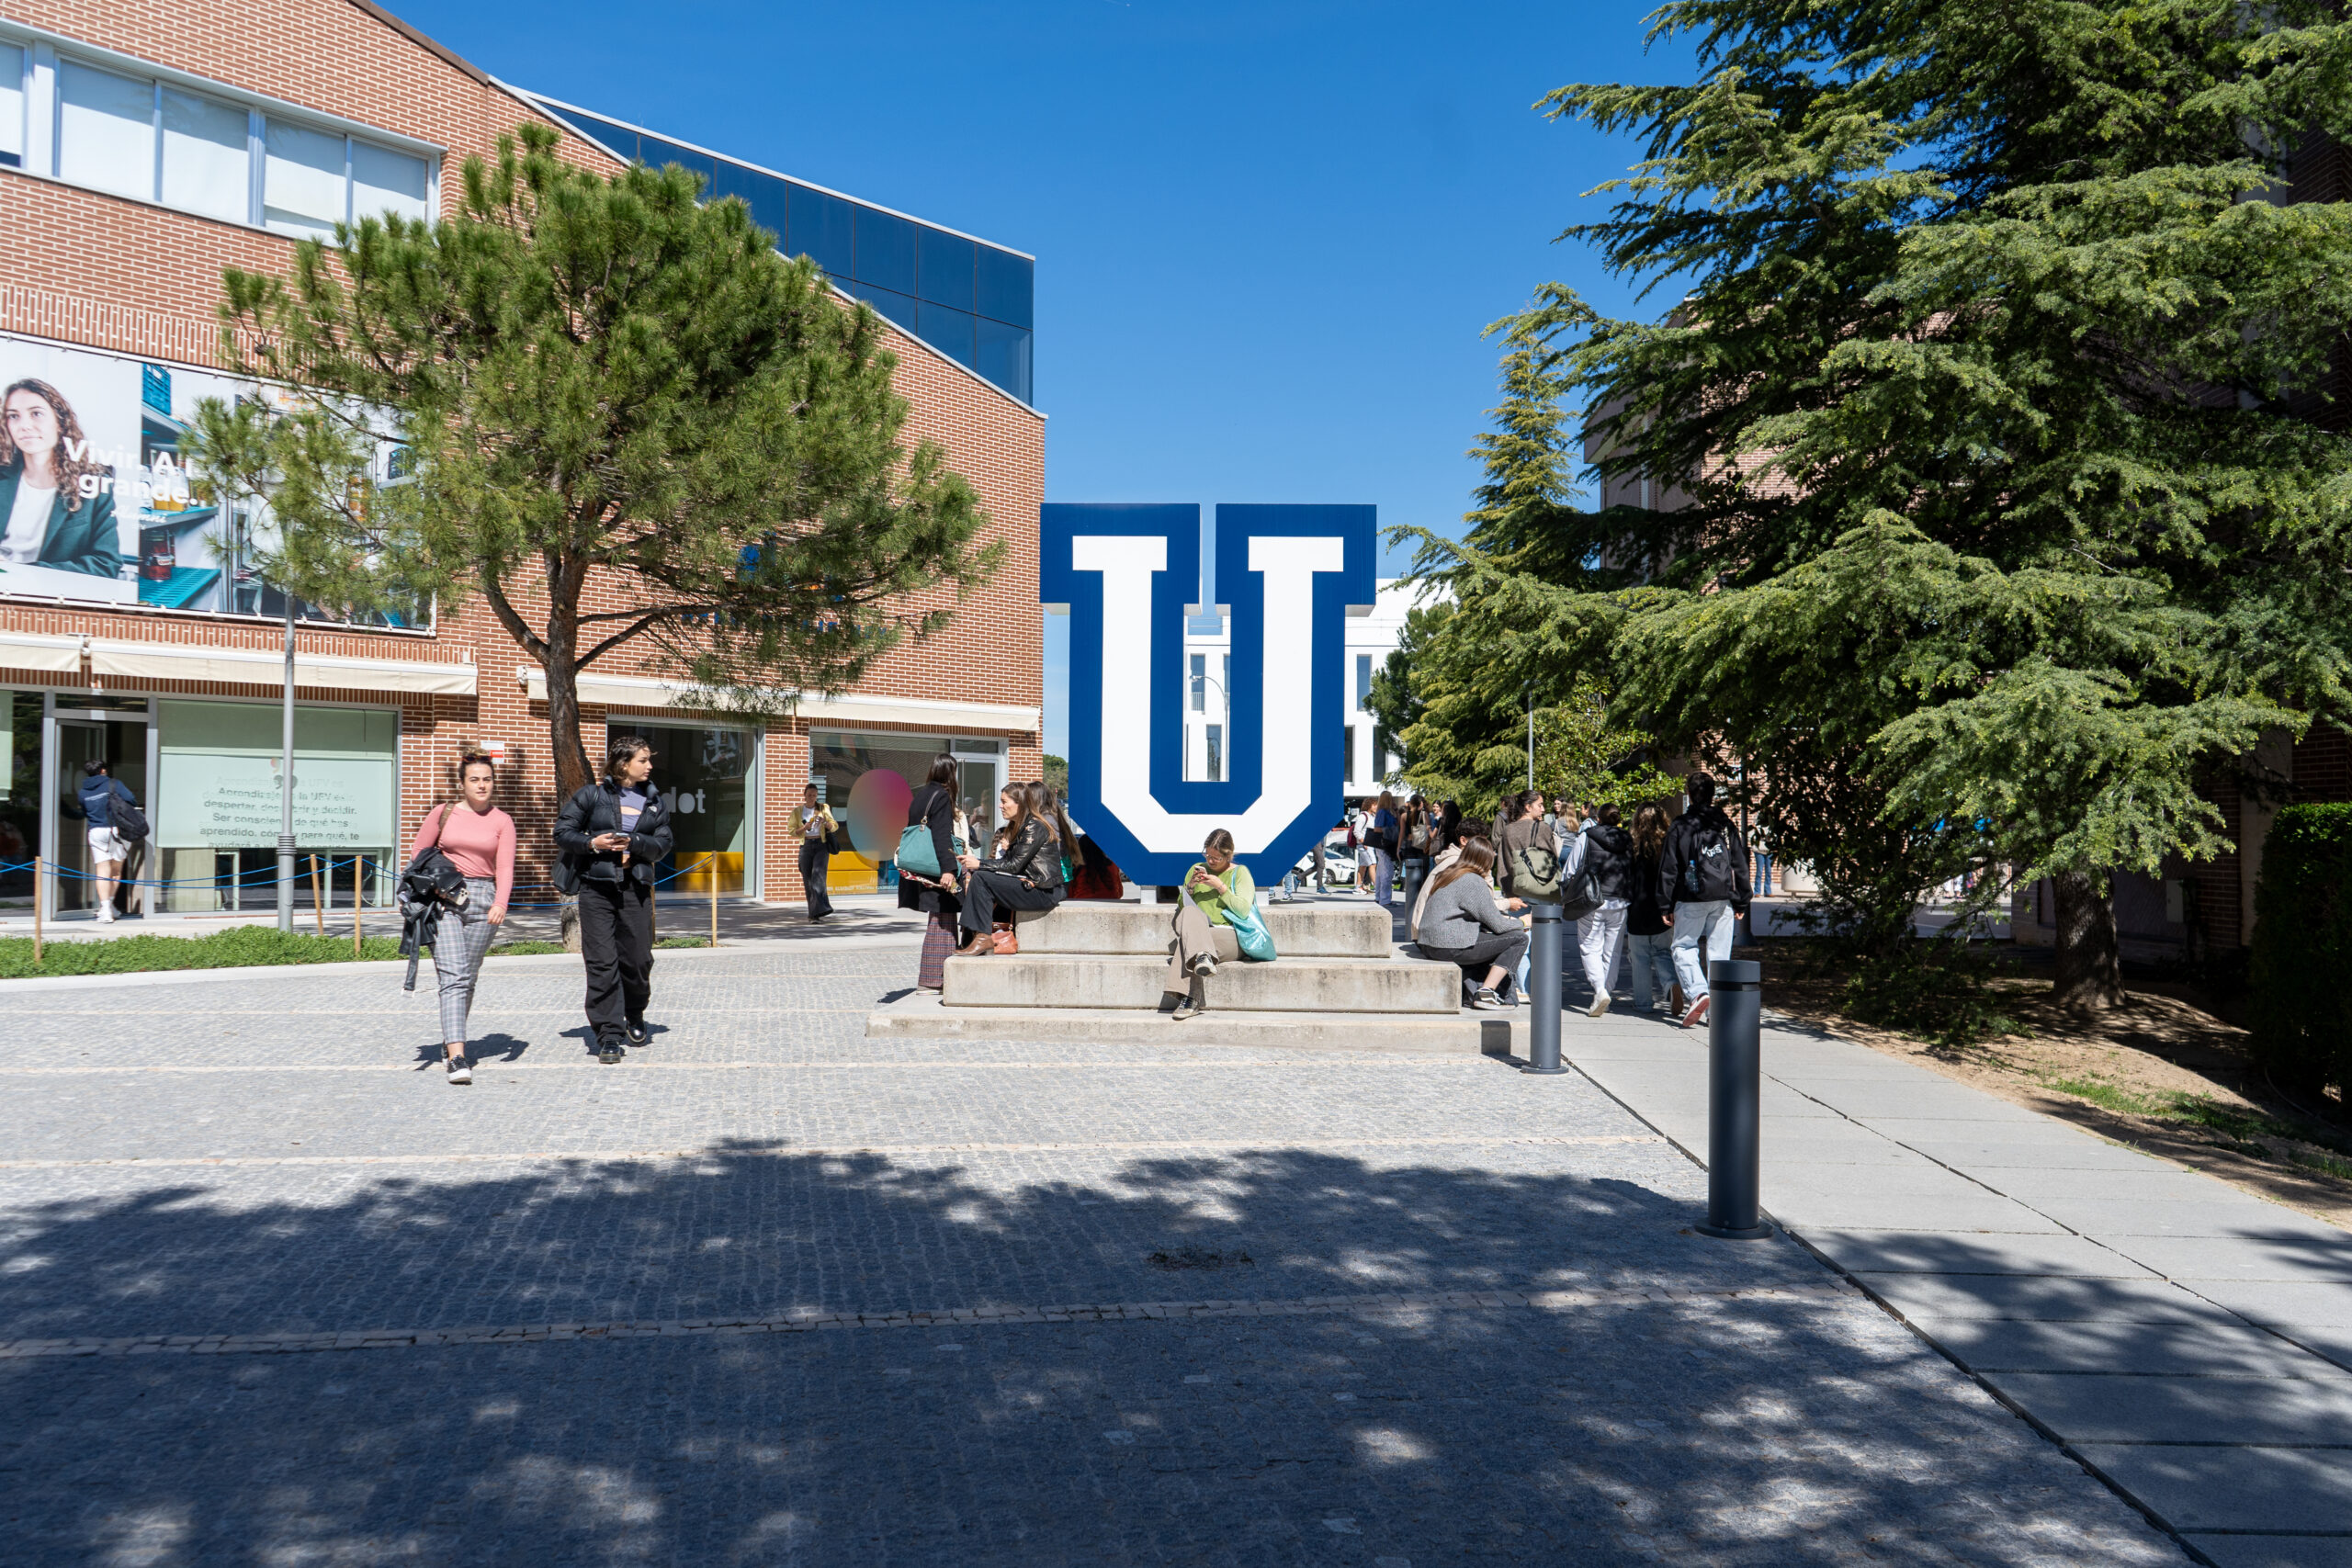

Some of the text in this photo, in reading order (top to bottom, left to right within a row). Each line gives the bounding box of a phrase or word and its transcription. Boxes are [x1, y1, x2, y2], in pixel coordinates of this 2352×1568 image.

[78, 473, 198, 505] grande.
[1041, 503, 1376, 886] U
[213, 813, 232, 822] Ser
[350, 832, 359, 840] te
